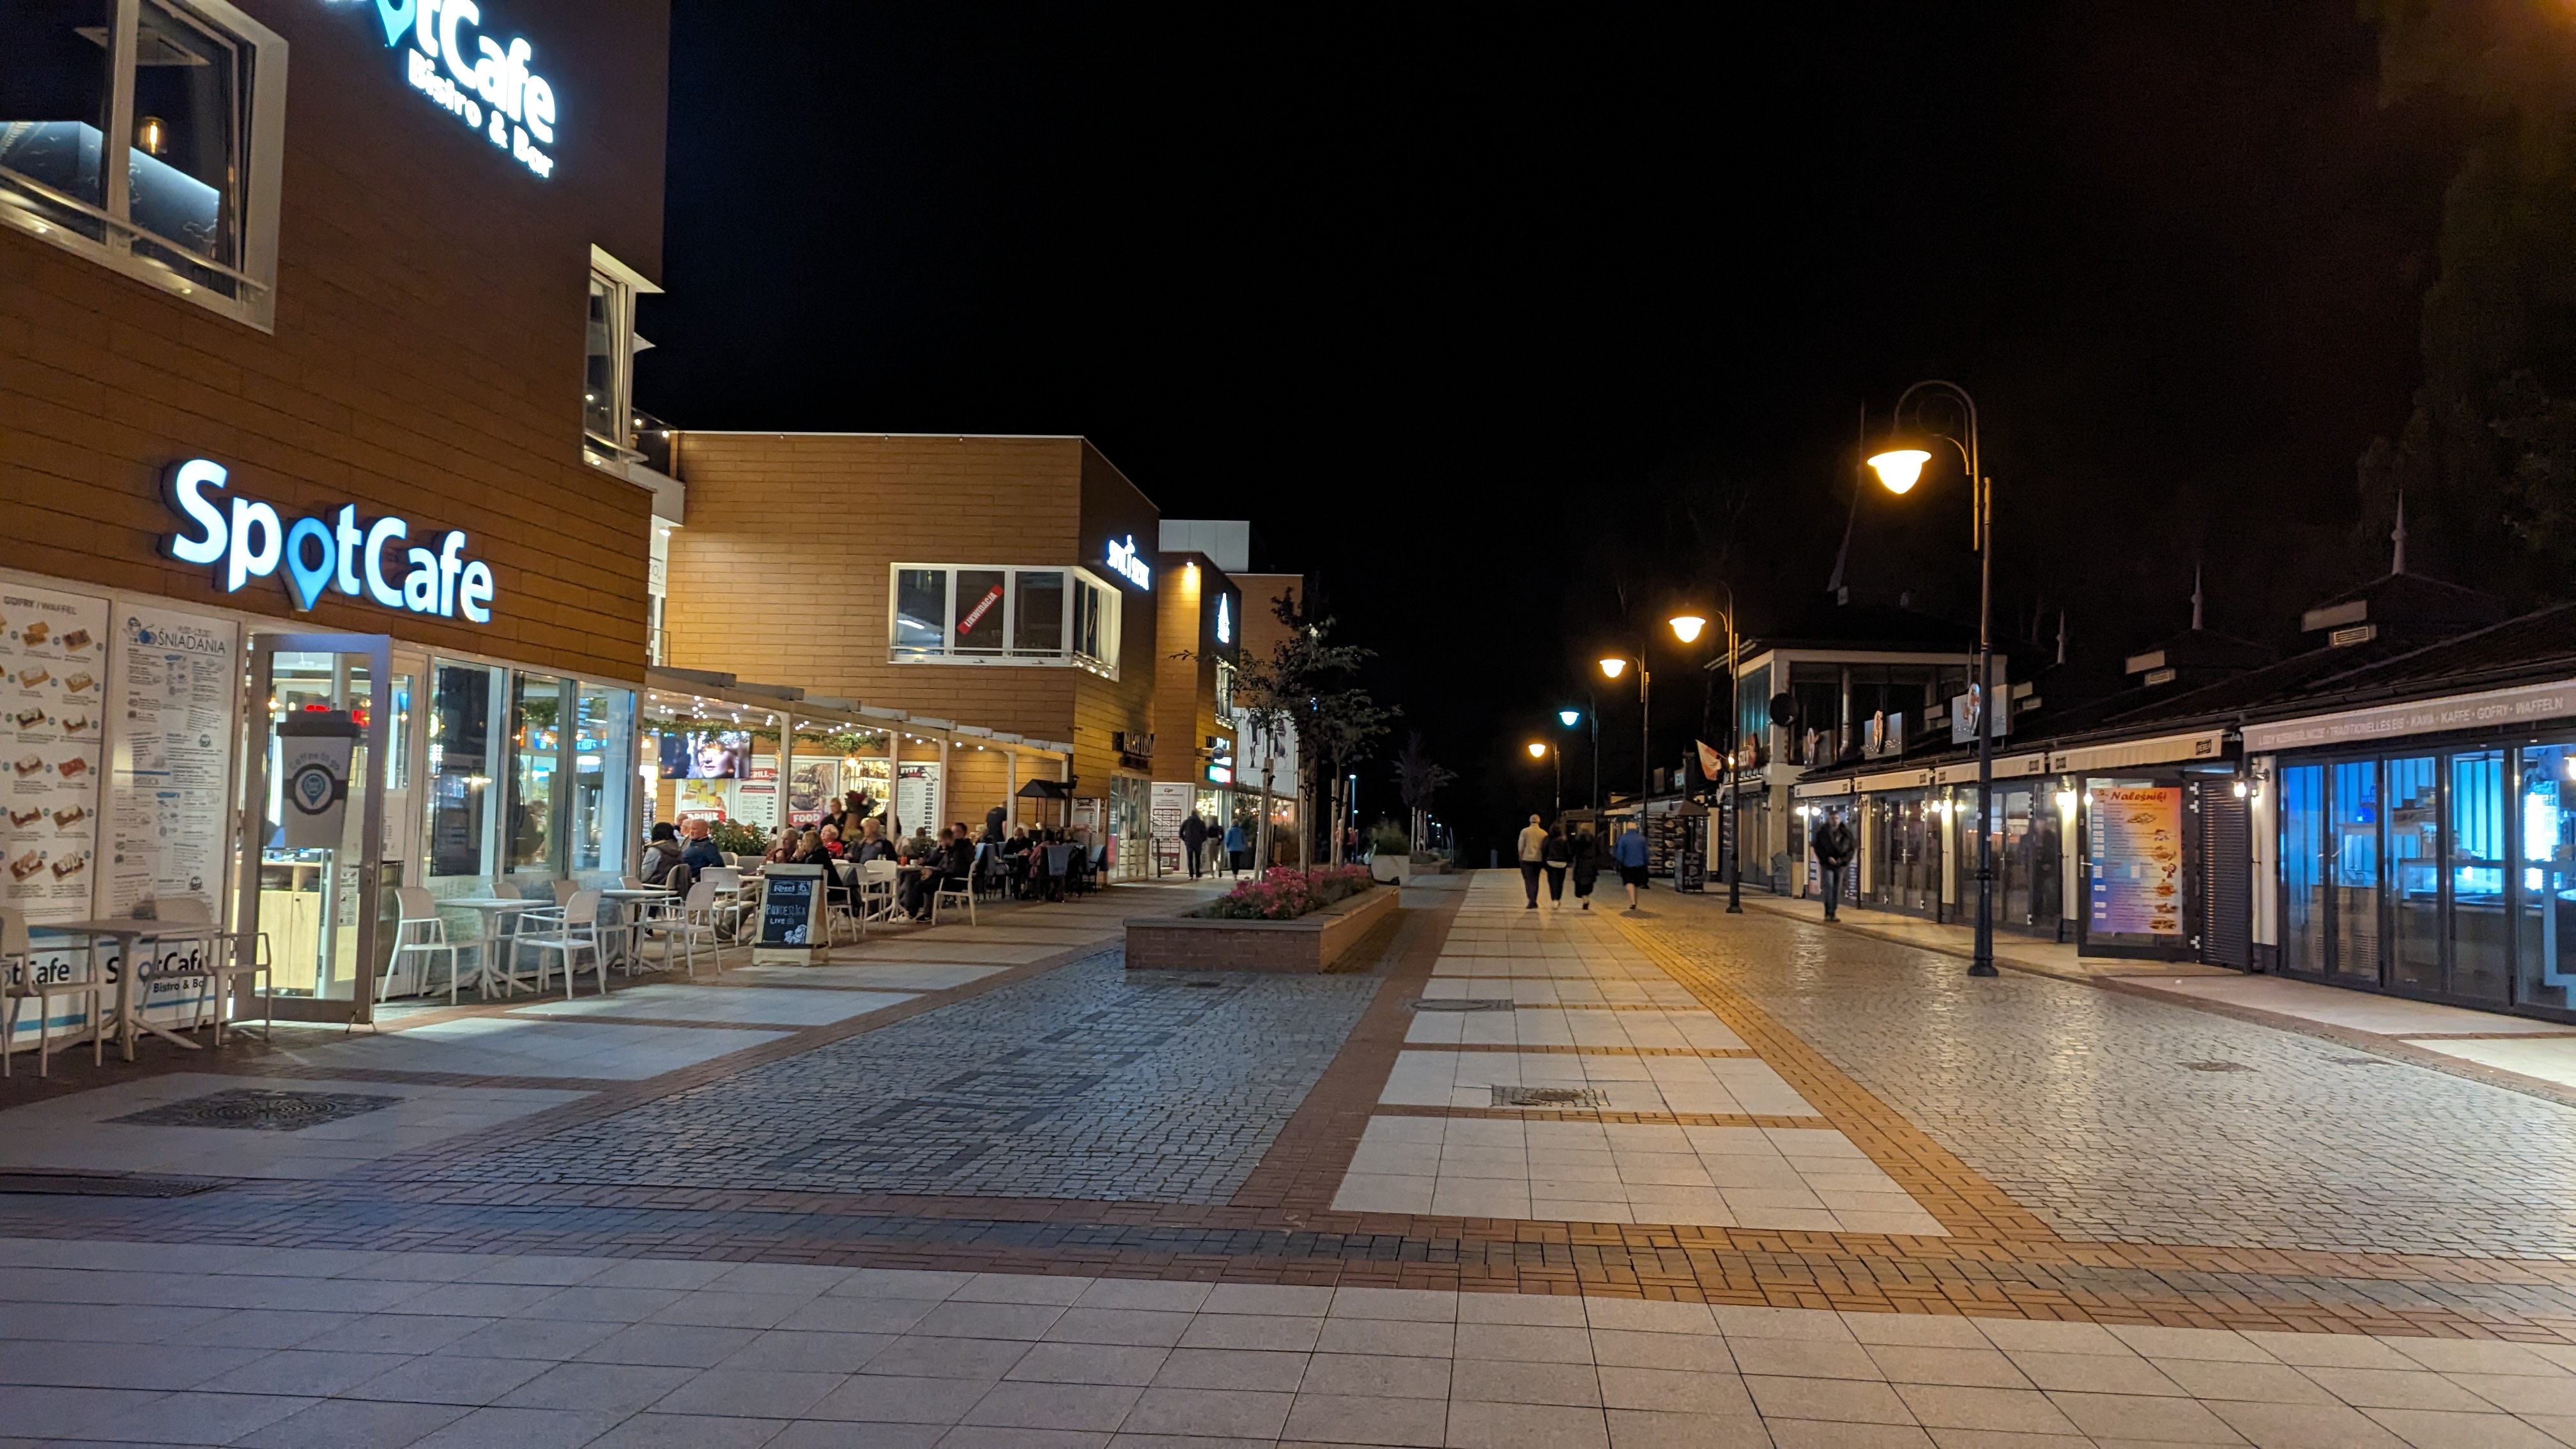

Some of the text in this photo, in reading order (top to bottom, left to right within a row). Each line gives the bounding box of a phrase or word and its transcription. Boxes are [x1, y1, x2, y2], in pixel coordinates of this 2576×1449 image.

[323, 0, 556, 143] otCafe
[408, 47, 554, 179] Bistro & Bar
[172, 458, 494, 624] SpotCafe
[963, 592, 998, 627] LIKWIDACJA
[158, 627, 226, 654] ŚNIADANIA
[2441, 709, 2471, 723] KAFFE
[2476, 704, 2509, 719] GOFRY
[2516, 696, 2564, 714] WAFFELN
[792, 813, 820, 823] FOOD
[153, 982, 180, 993] Bistro
[183, 979, 190, 989] &
